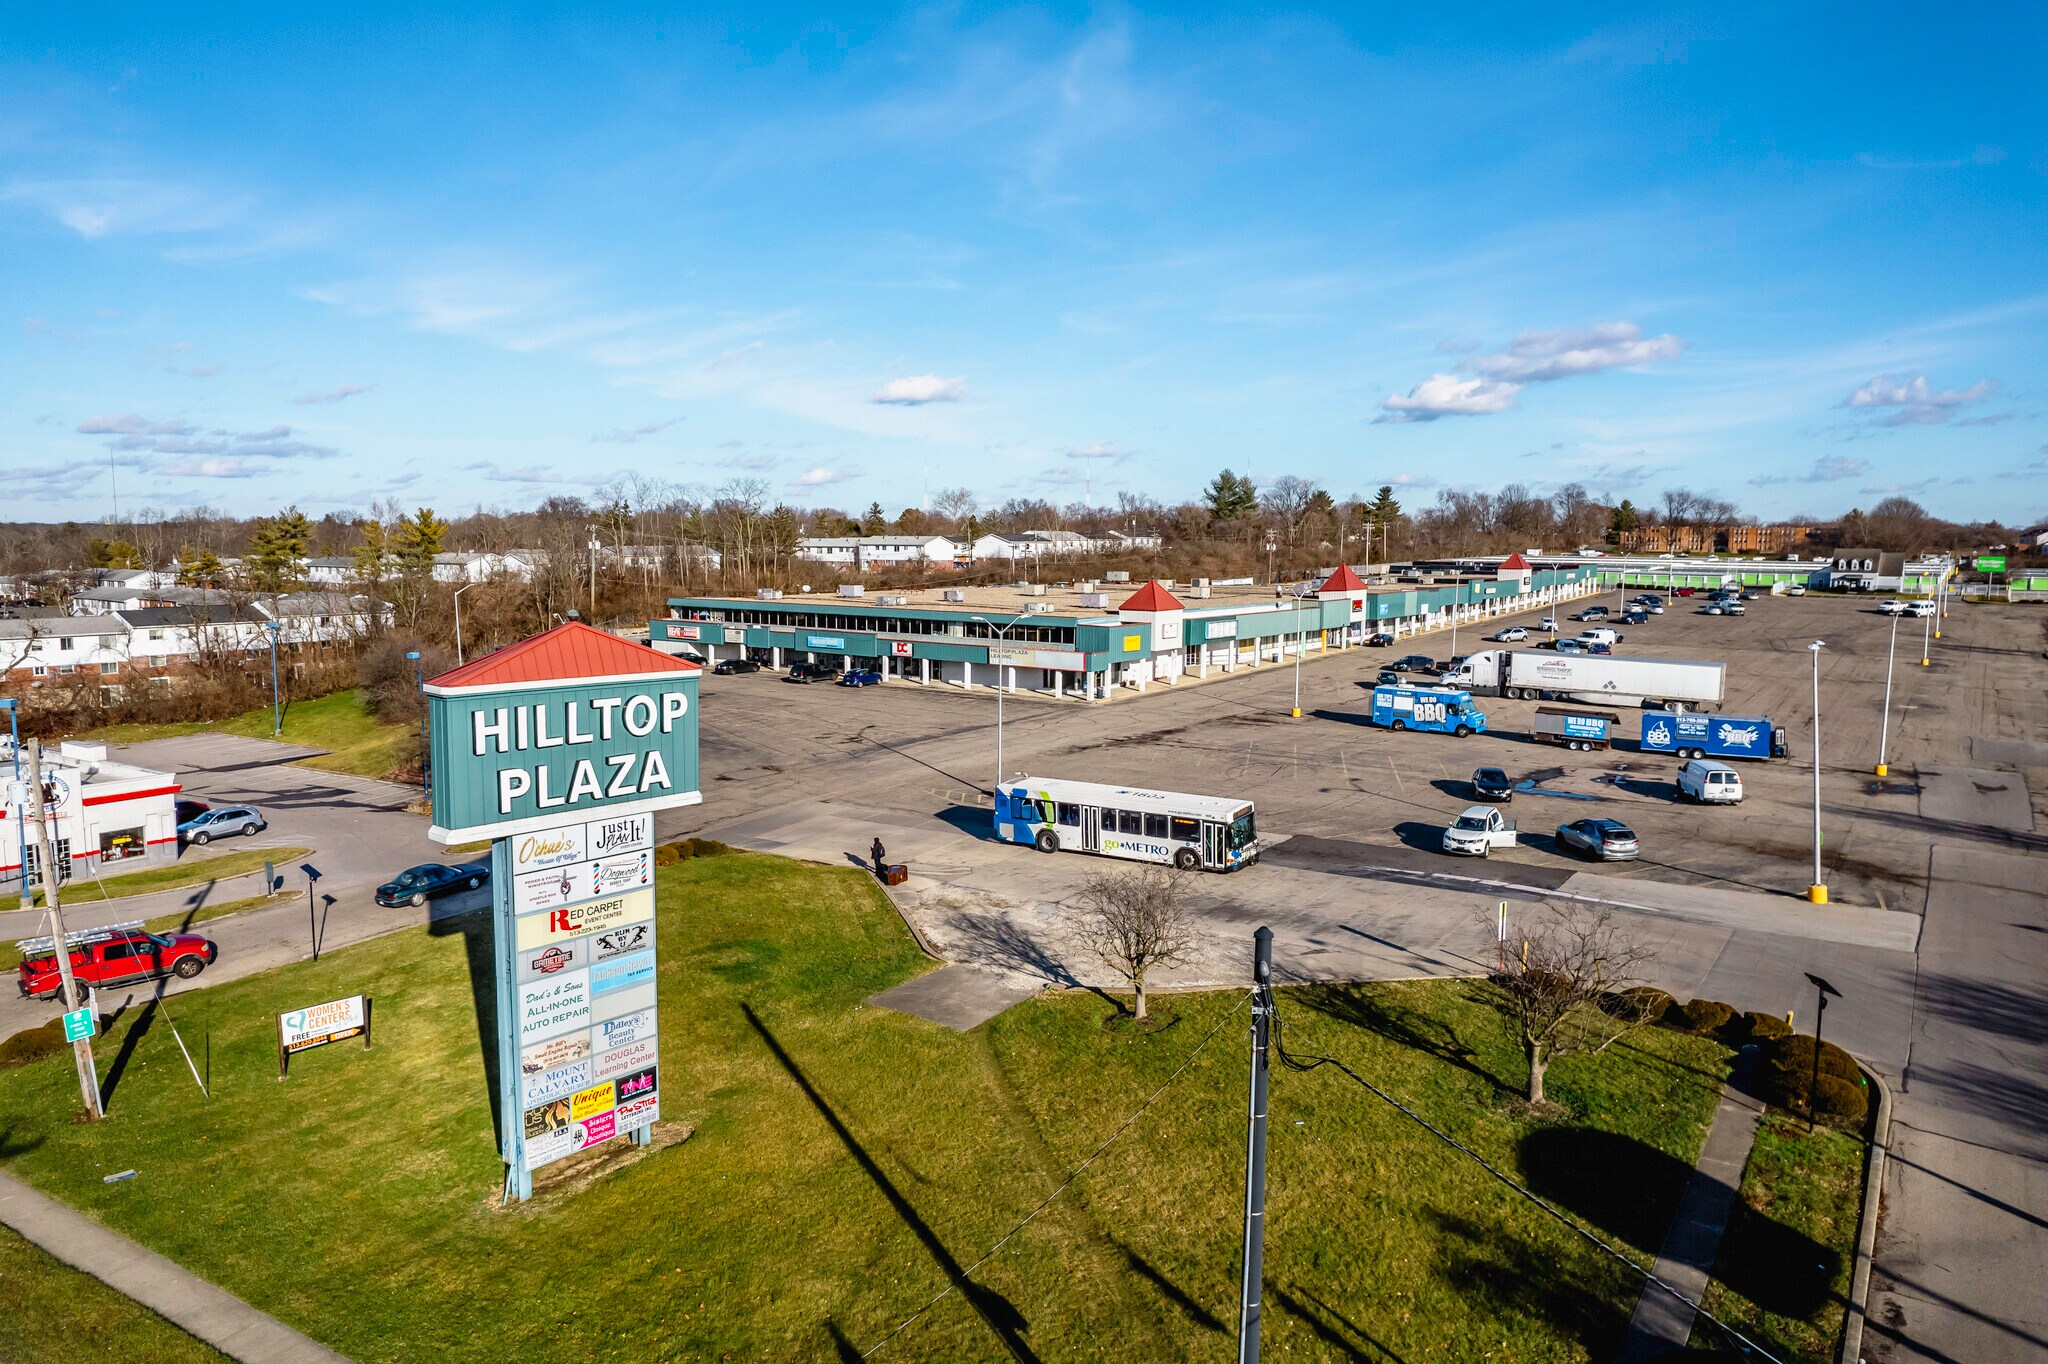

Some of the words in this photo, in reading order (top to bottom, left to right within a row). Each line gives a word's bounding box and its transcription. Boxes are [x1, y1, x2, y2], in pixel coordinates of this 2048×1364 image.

[896, 642, 908, 653] DC
[1414, 703, 1446, 723] BBQ
[472, 691, 689, 756] HILLTOP
[1567, 717, 1577, 725] WE
[1577, 717, 1586, 726] DO
[1586, 718, 1604, 728] BBQ
[1647, 730, 1671, 741] BBQ
[1727, 733, 1751, 743] BBQ
[498, 750, 672, 814] PLAZA
[596, 819, 628, 849] Just
[605, 833, 631, 852] PLAN
[1125, 841, 1168, 855] METRO
[600, 863, 640, 880] Dogwood
[550, 909, 585, 932] RED
[586, 900, 623, 916] CARPET
[584, 916, 602, 924] EVENT
[602, 911, 623, 920] CENTER
[614, 929, 630, 937] RUN
[532, 952, 572, 969] GAMETIME
[592, 964, 627, 983] Jackson
[636, 966, 654, 976] SERVICE
[526, 989, 551, 1004] Dad's
[554, 985, 561, 996] &
[563, 983, 583, 993] Sons
[307, 1000, 351, 1019] WOMEN'S
[527, 994, 584, 1018] ALL-IN-ONE
[309, 1010, 351, 1029] CENTERS
[522, 1018, 550, 1033] AUTO
[552, 1006, 589, 1024] REPAIR
[603, 1017, 641, 1036] Dudley's
[291, 1031, 311, 1042] FREE
[334, 1029, 354, 1039] OPEN
[608, 1028, 635, 1041] Beauty
[608, 1035, 635, 1048] Center
[604, 1043, 646, 1064] DOUGLAS
[546, 1061, 588, 1083] MOUNT
[595, 1061, 628, 1078] Learning
[630, 1052, 656, 1066] Center
[528, 1072, 588, 1099] CALVARY
[563, 1079, 591, 1093] CHURCH
[573, 1086, 612, 1106] Unique
[617, 1105, 633, 1116] Pro
[621, 1109, 644, 1121] LETTERING
[525, 1114, 543, 1127] US
[588, 1113, 613, 1128] Sisters
[590, 1123, 612, 1135] Unique
[587, 1128, 615, 1144] Boutique
